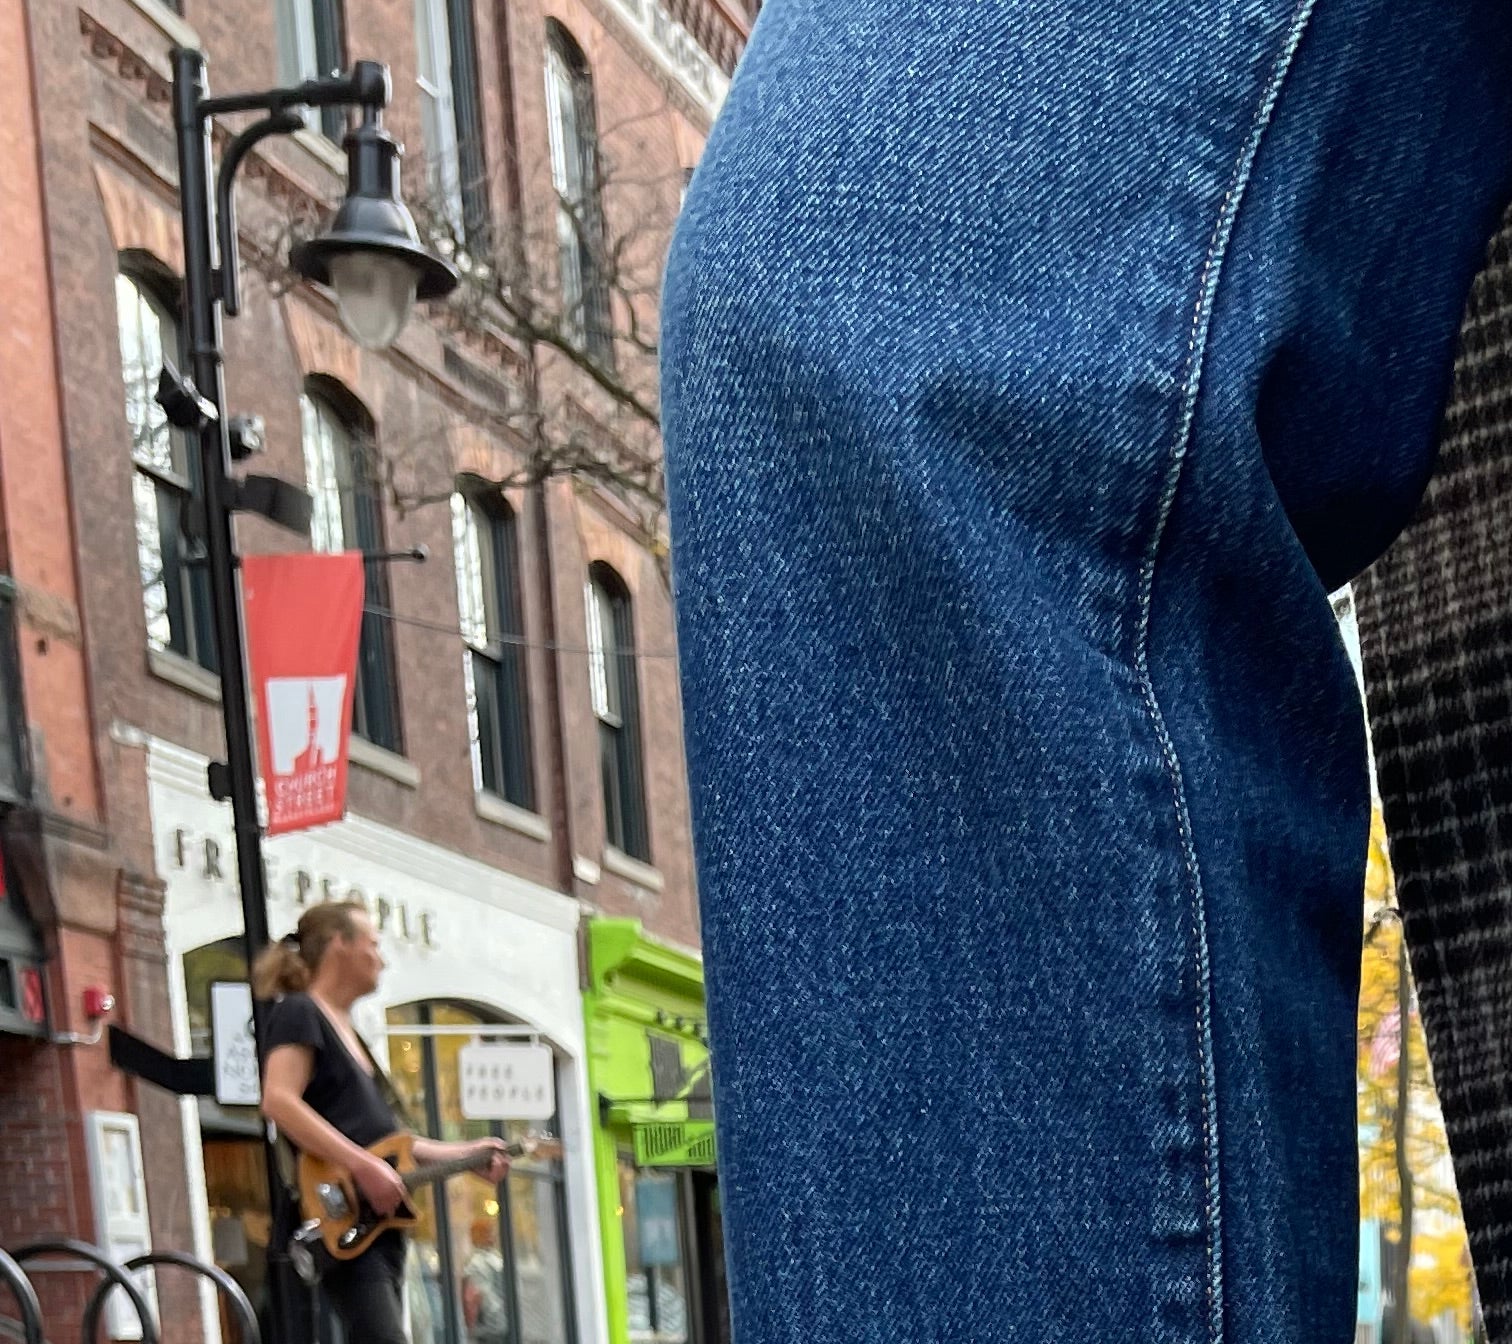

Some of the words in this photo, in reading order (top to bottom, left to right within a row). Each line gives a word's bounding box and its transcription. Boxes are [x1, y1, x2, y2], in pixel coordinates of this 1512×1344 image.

[275, 765, 337, 798] CHURCH
[275, 786, 335, 813] STREET
[174, 827, 279, 901] FRE
[465, 1063, 513, 1080] FREE
[467, 1083, 545, 1102] PEOPLE
